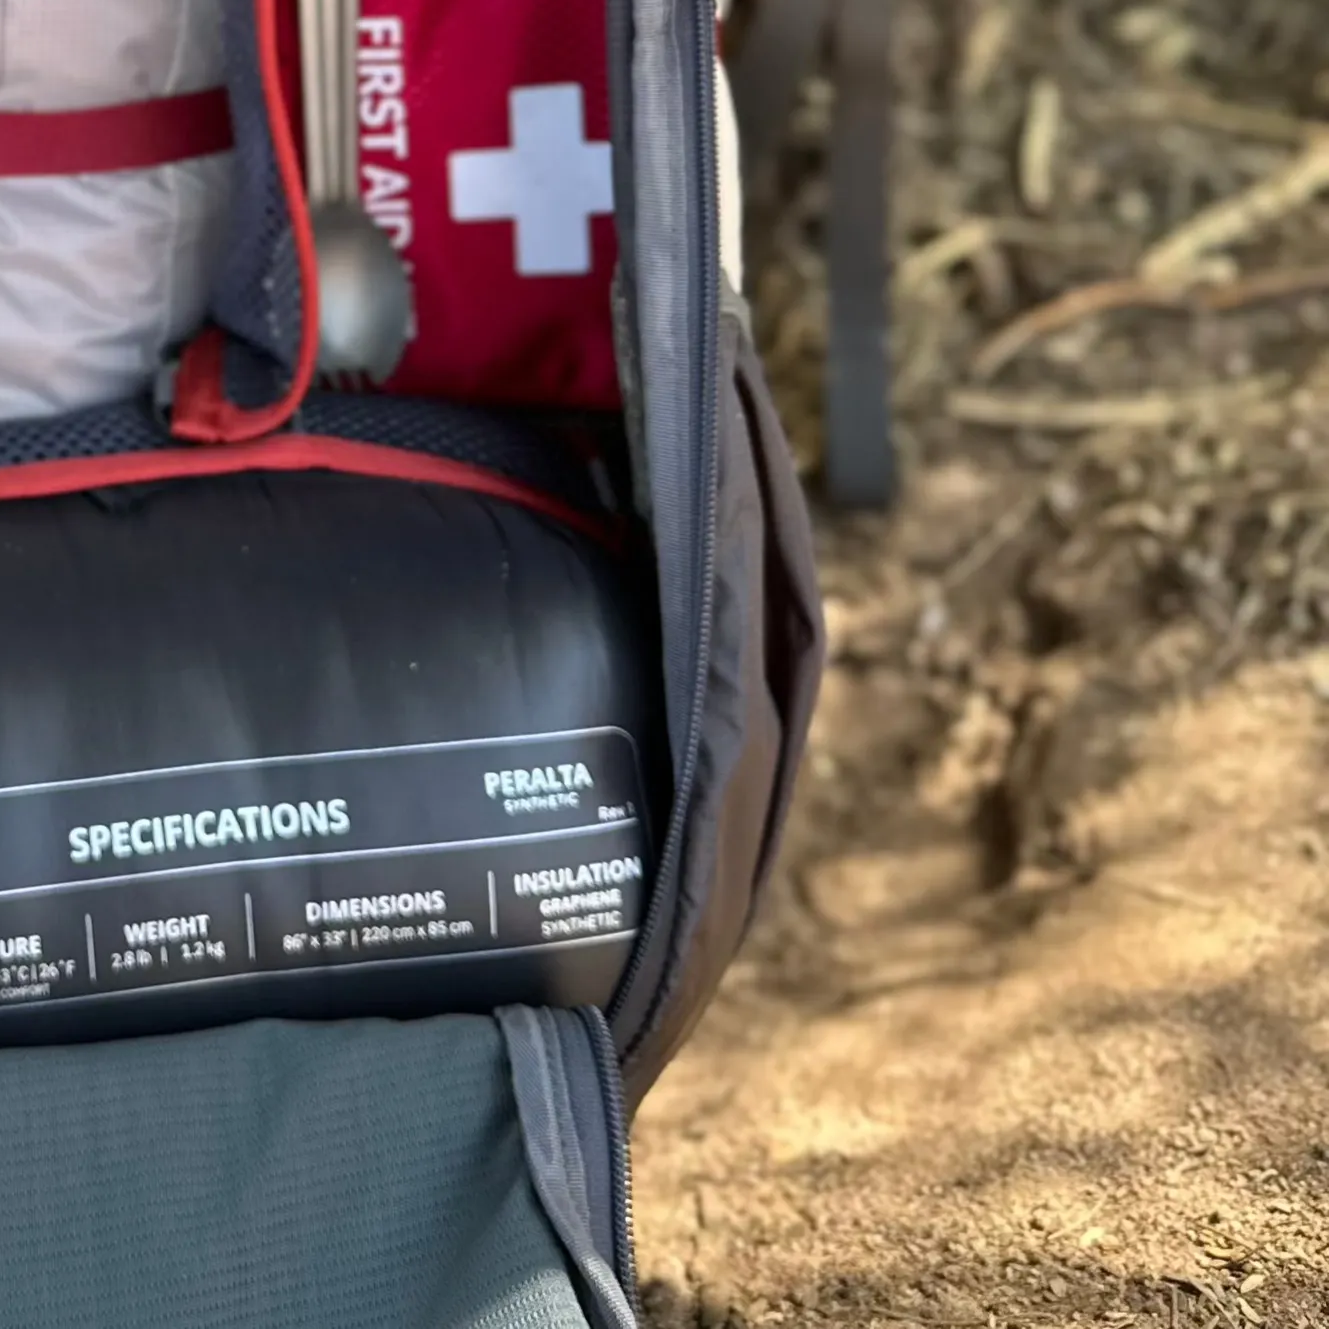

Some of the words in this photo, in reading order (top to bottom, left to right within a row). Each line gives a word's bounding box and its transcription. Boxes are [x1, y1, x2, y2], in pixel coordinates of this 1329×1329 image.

[357, 17, 409, 161] FIRST
[483, 762, 594, 800] PERALTA
[503, 791, 580, 817] SYNTHETIC
[68, 798, 351, 863] SPECIFICATIONS
[513, 856, 643, 898] INSULATION
[305, 890, 447, 928] DIMENSIONS
[539, 887, 624, 918] GRAPHENE
[123, 914, 211, 948] WEIGHT
[361, 925, 391, 947] 220
[392, 926, 416, 944] cm
[449, 919, 474, 936] cm
[540, 909, 624, 940] SYNTHETIC
